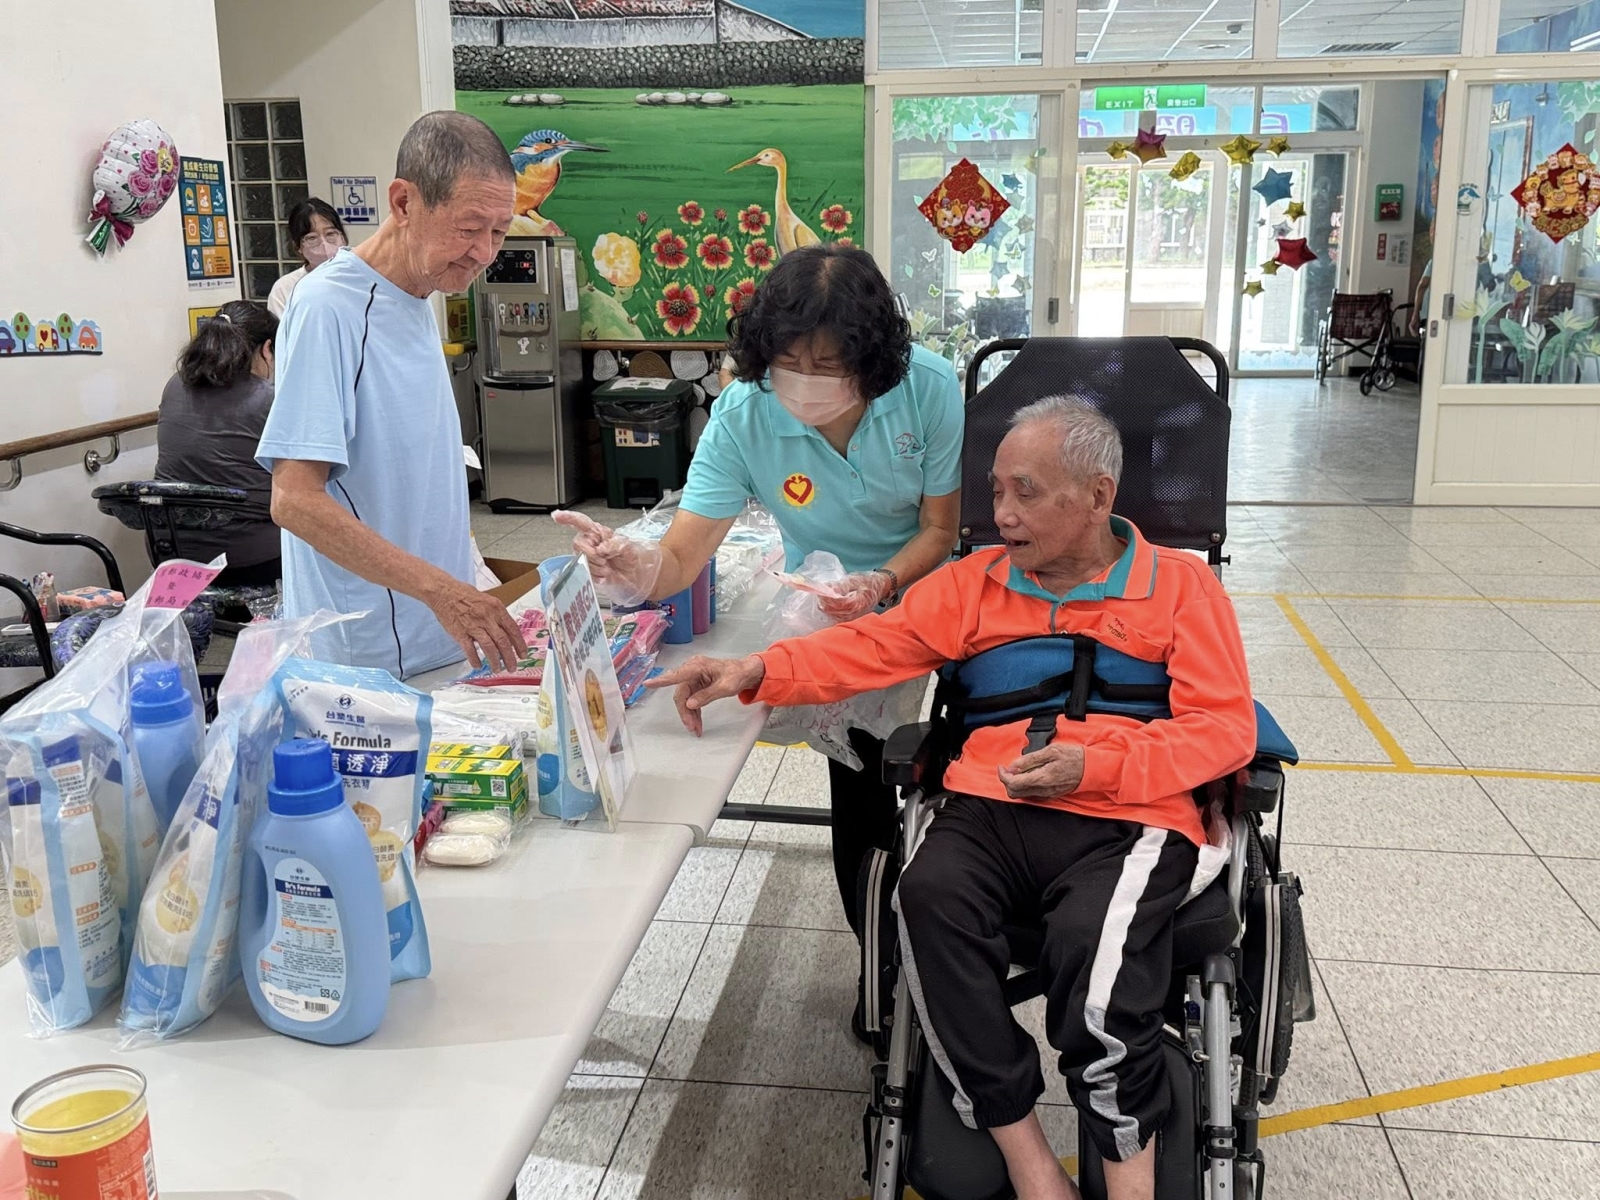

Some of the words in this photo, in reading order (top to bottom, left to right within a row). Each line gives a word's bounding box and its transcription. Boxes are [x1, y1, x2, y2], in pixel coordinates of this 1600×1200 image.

[1105, 100, 1134, 108] EXIT
[336, 207, 376, 216] 無障礙廁所
[325, 710, 366, 724] 台塑生醫
[332, 732, 392, 748] Formula
[296, 883, 321, 893] Formula
